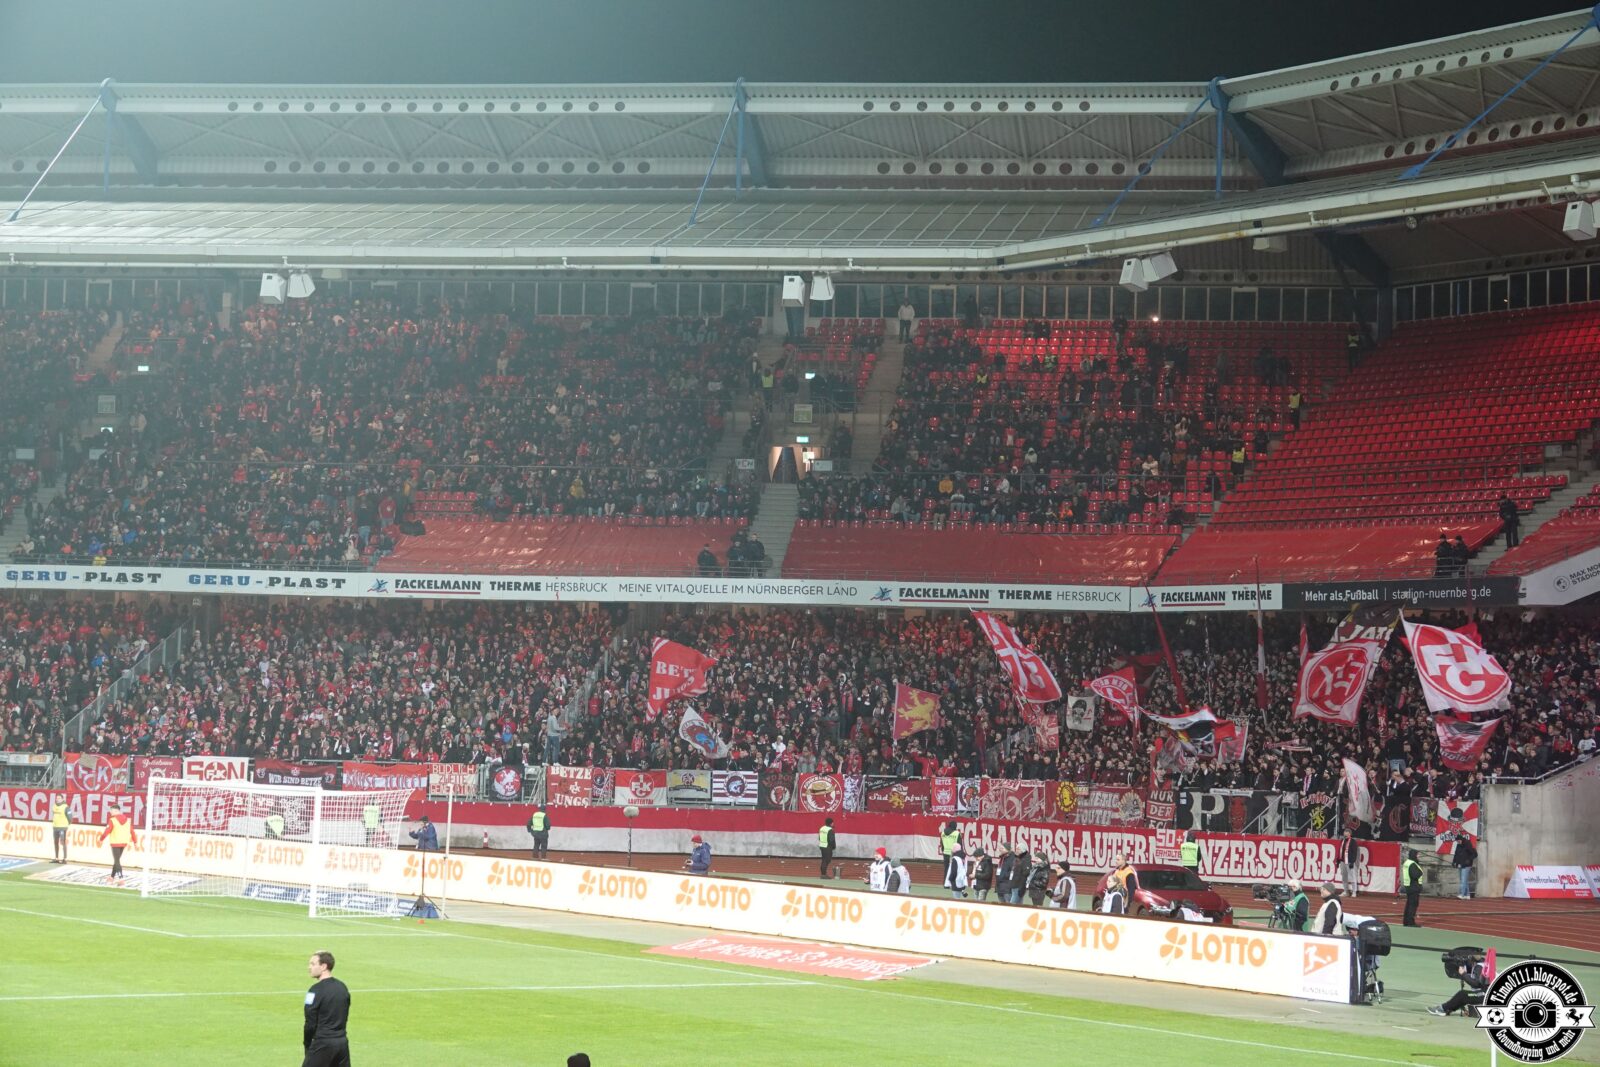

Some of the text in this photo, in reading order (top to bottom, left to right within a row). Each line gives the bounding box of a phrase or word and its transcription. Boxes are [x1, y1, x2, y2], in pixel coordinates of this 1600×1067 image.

[1569, 568, 1586, 580] MAX
[395, 579, 608, 593] FACKELMANN THERME HERSBRUCK
[619, 582, 858, 596] MEINE VITALQUELLE IM NÜRNBERGER LAND
[899, 588, 1122, 602] FACKELMANN THERME HERSBRUCK
[1305, 589, 1379, 601] Mehr als Fußball
[1392, 586, 1491, 599] stadion-nuernbeg.de
[1161, 590, 1272, 602] FACKELMANN THERME
[268, 773, 282, 784] WIR
[283, 775, 300, 785] SIND
[550, 766, 592, 780] BETZE
[1150, 791, 1174, 803] NUR
[1150, 805, 1172, 817] DER
[15, 825, 43, 843] LOTTO
[199, 839, 234, 860] LOTTO
[268, 845, 304, 866] LOTTO
[342, 852, 382, 874] LOTTO
[424, 858, 464, 881] LOTTO
[506, 864, 552, 890] LOTTO
[598, 873, 648, 900] LOTTO
[698, 882, 751, 912] LOTTO
[805, 893, 863, 923] LOTTO
[921, 904, 985, 936] LOTTO
[1051, 917, 1120, 951] LOTTO
[1191, 931, 1268, 967] LOTTO
